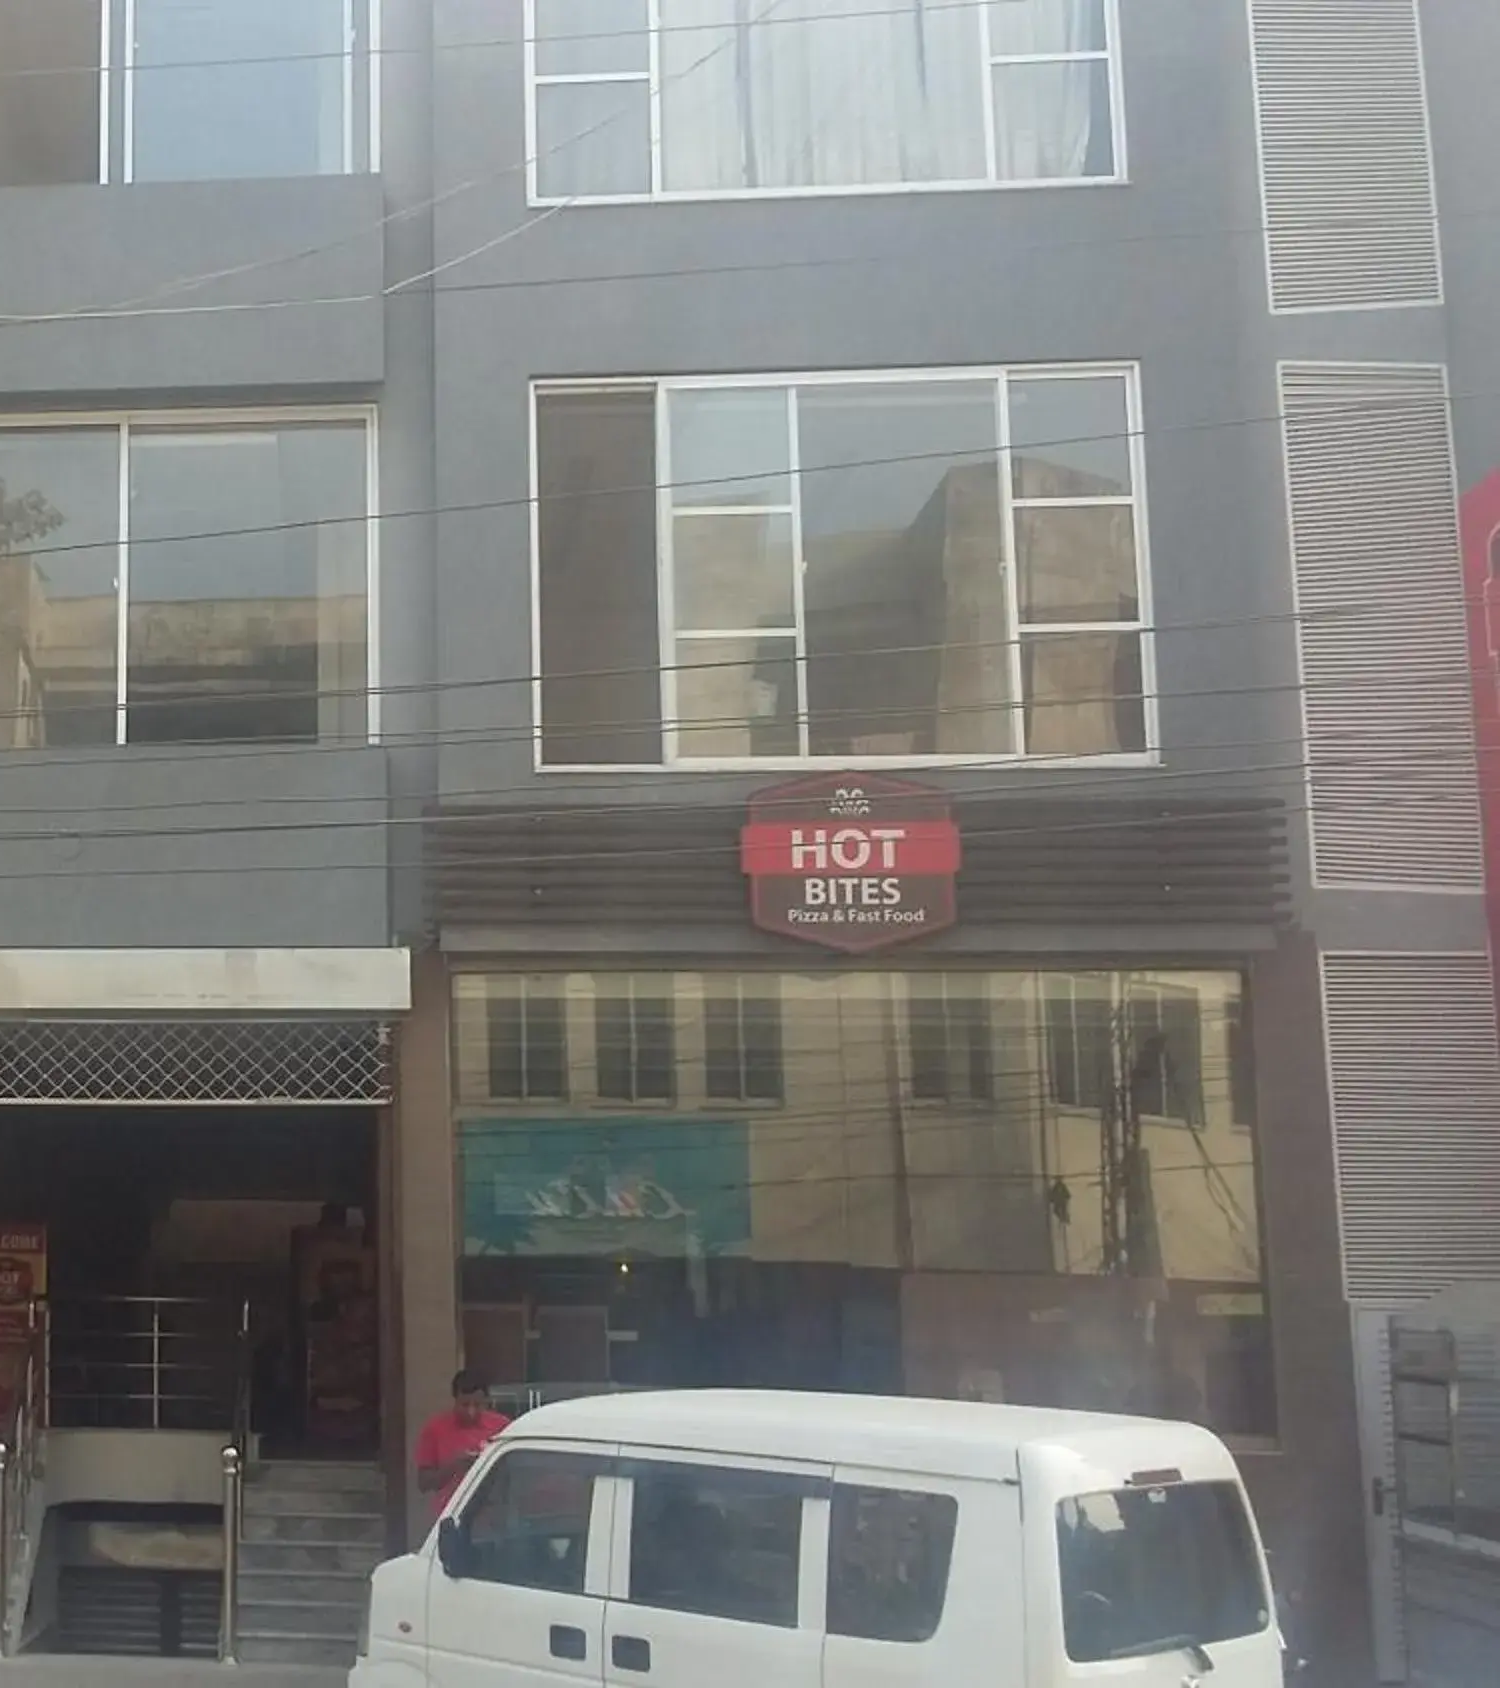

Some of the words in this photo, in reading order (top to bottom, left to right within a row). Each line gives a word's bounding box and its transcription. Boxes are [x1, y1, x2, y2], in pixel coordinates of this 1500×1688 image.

[791, 829, 905, 869] HOT
[804, 877, 902, 906] BITES
[787, 909, 829, 923] Pizza
[832, 909, 845, 923] &
[848, 909, 881, 923] Fast
[884, 909, 925, 923] Food
